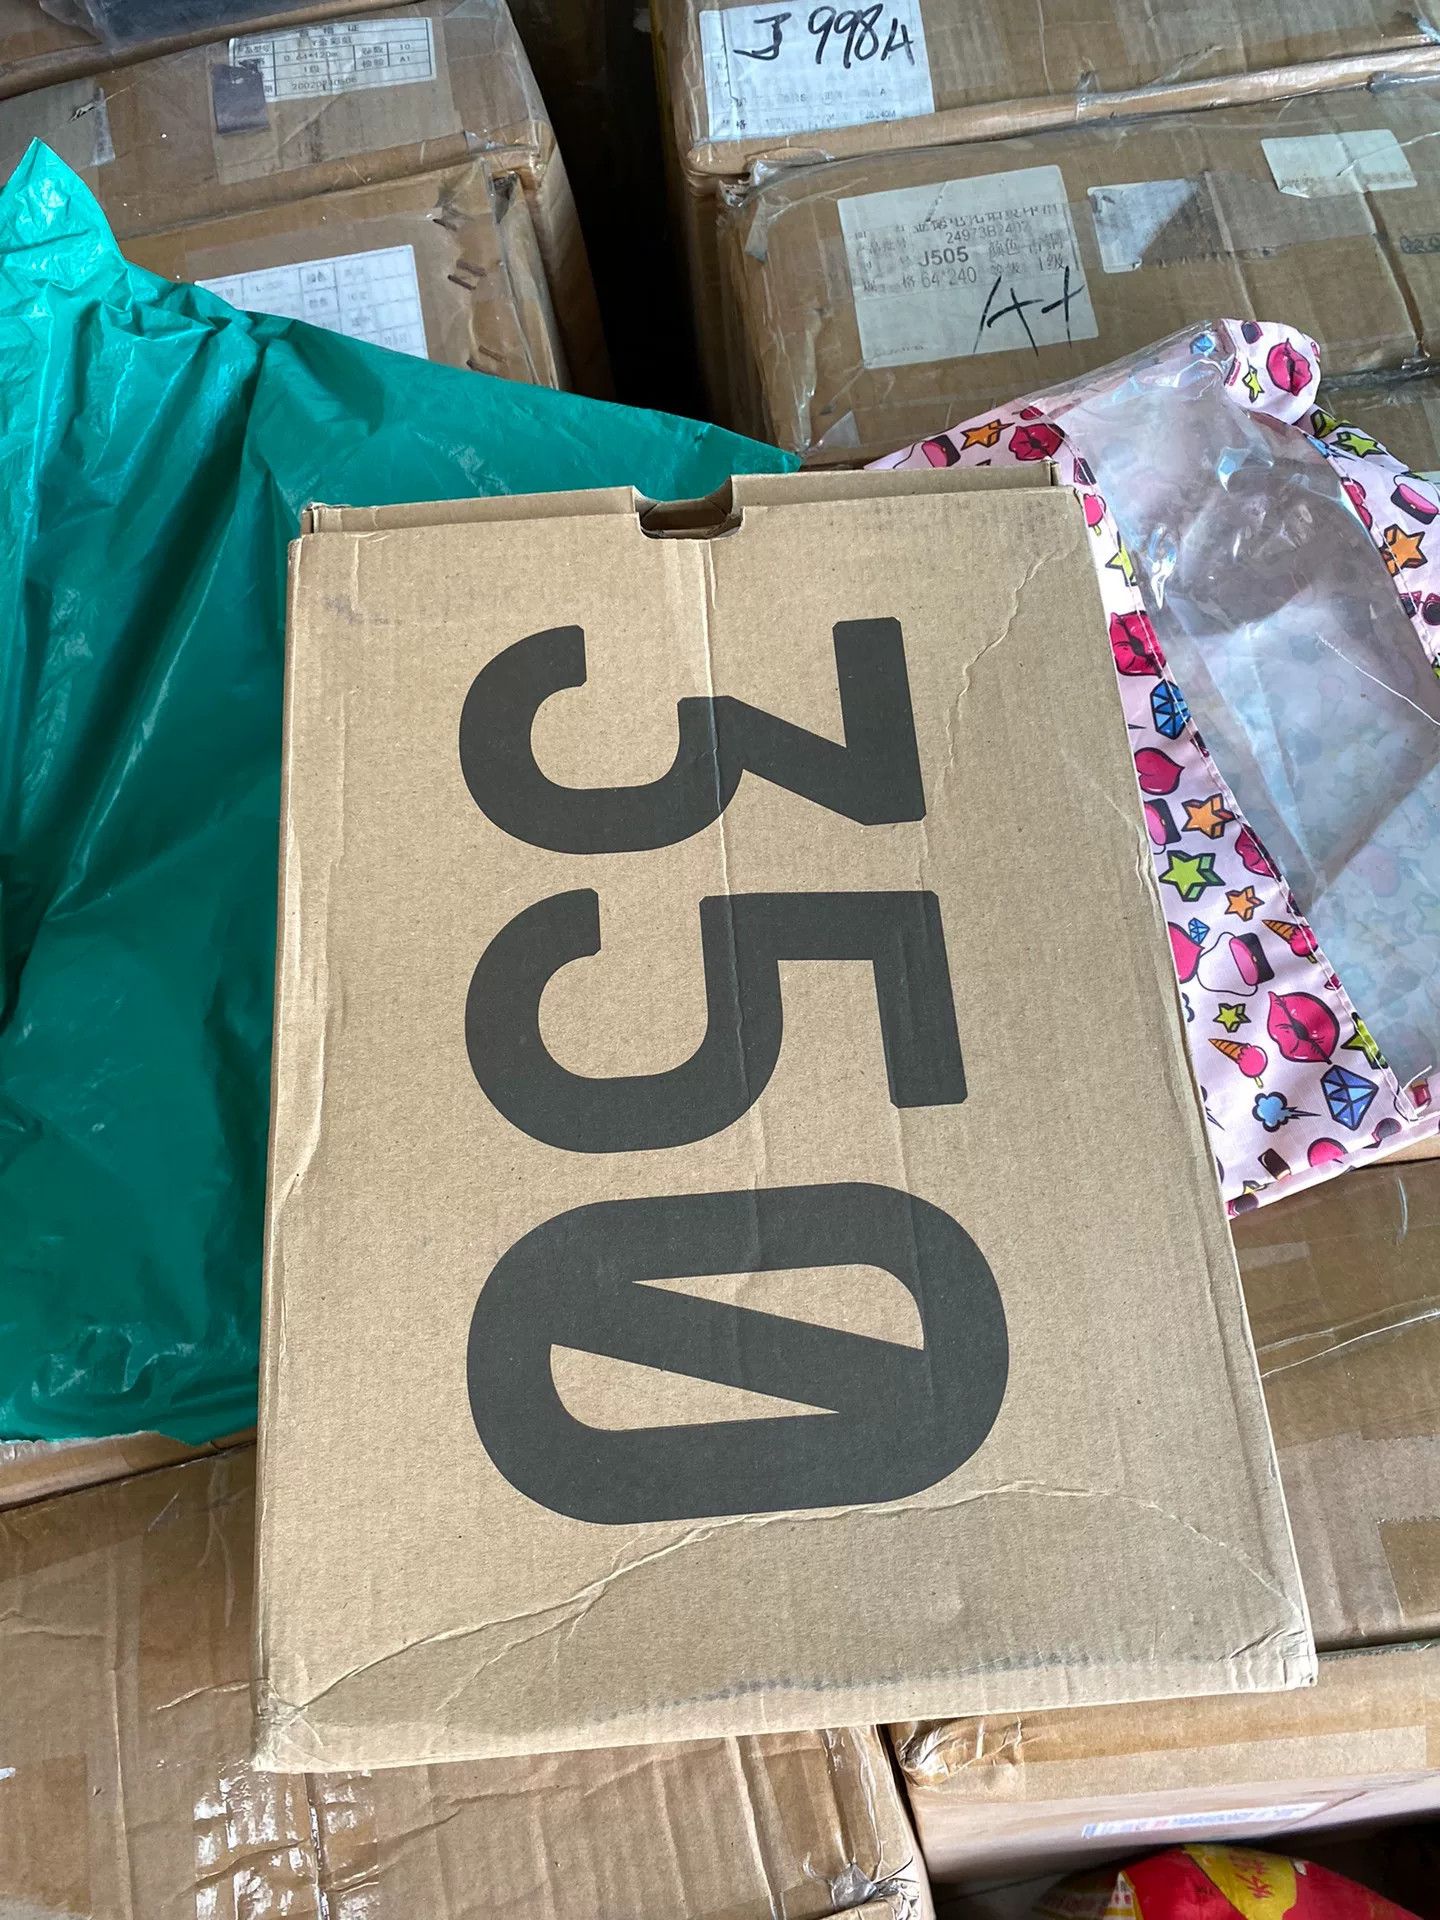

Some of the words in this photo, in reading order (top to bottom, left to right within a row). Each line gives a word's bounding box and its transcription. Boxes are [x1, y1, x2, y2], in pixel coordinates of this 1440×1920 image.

[733, 12, 792, 61] J
[919, 246, 969, 268] J505
[459, 617, 1010, 1525] 350
